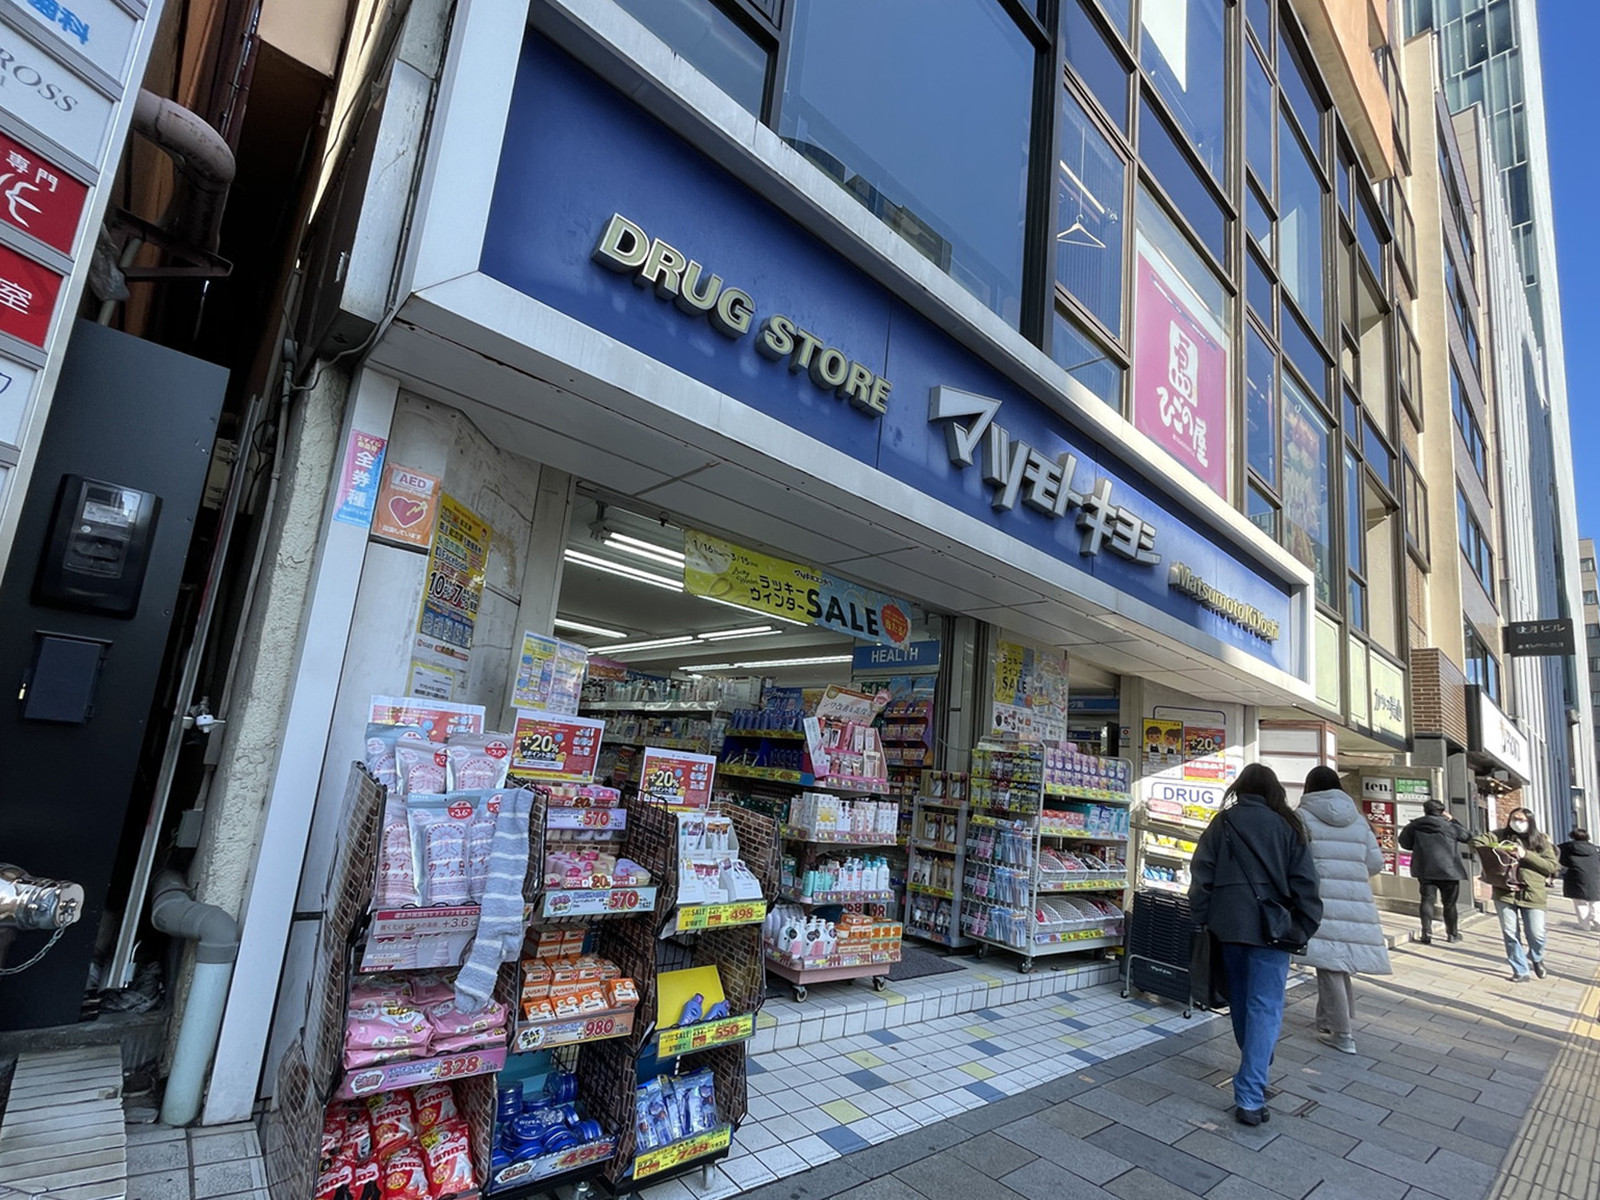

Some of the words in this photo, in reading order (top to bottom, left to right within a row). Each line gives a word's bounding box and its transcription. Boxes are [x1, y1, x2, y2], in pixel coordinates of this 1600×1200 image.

[596, 213, 755, 336] DRUG
[760, 314, 893, 417] STORE
[399, 474, 427, 489] AED
[930, 384, 1161, 566] マツモトキヨシ
[806, 588, 880, 637] SALE
[871, 647, 920, 665] HEALTH
[1163, 786, 1214, 805] DRUG
[1365, 782, 1393, 793] ten.
[584, 811, 610, 827] 570
[610, 890, 638, 909] 570
[730, 908, 754, 920] 498
[585, 1018, 614, 1037] 980
[715, 1023, 739, 1039] 550
[440, 1056, 479, 1078] 328
[560, 1143, 612, 1167] 498
